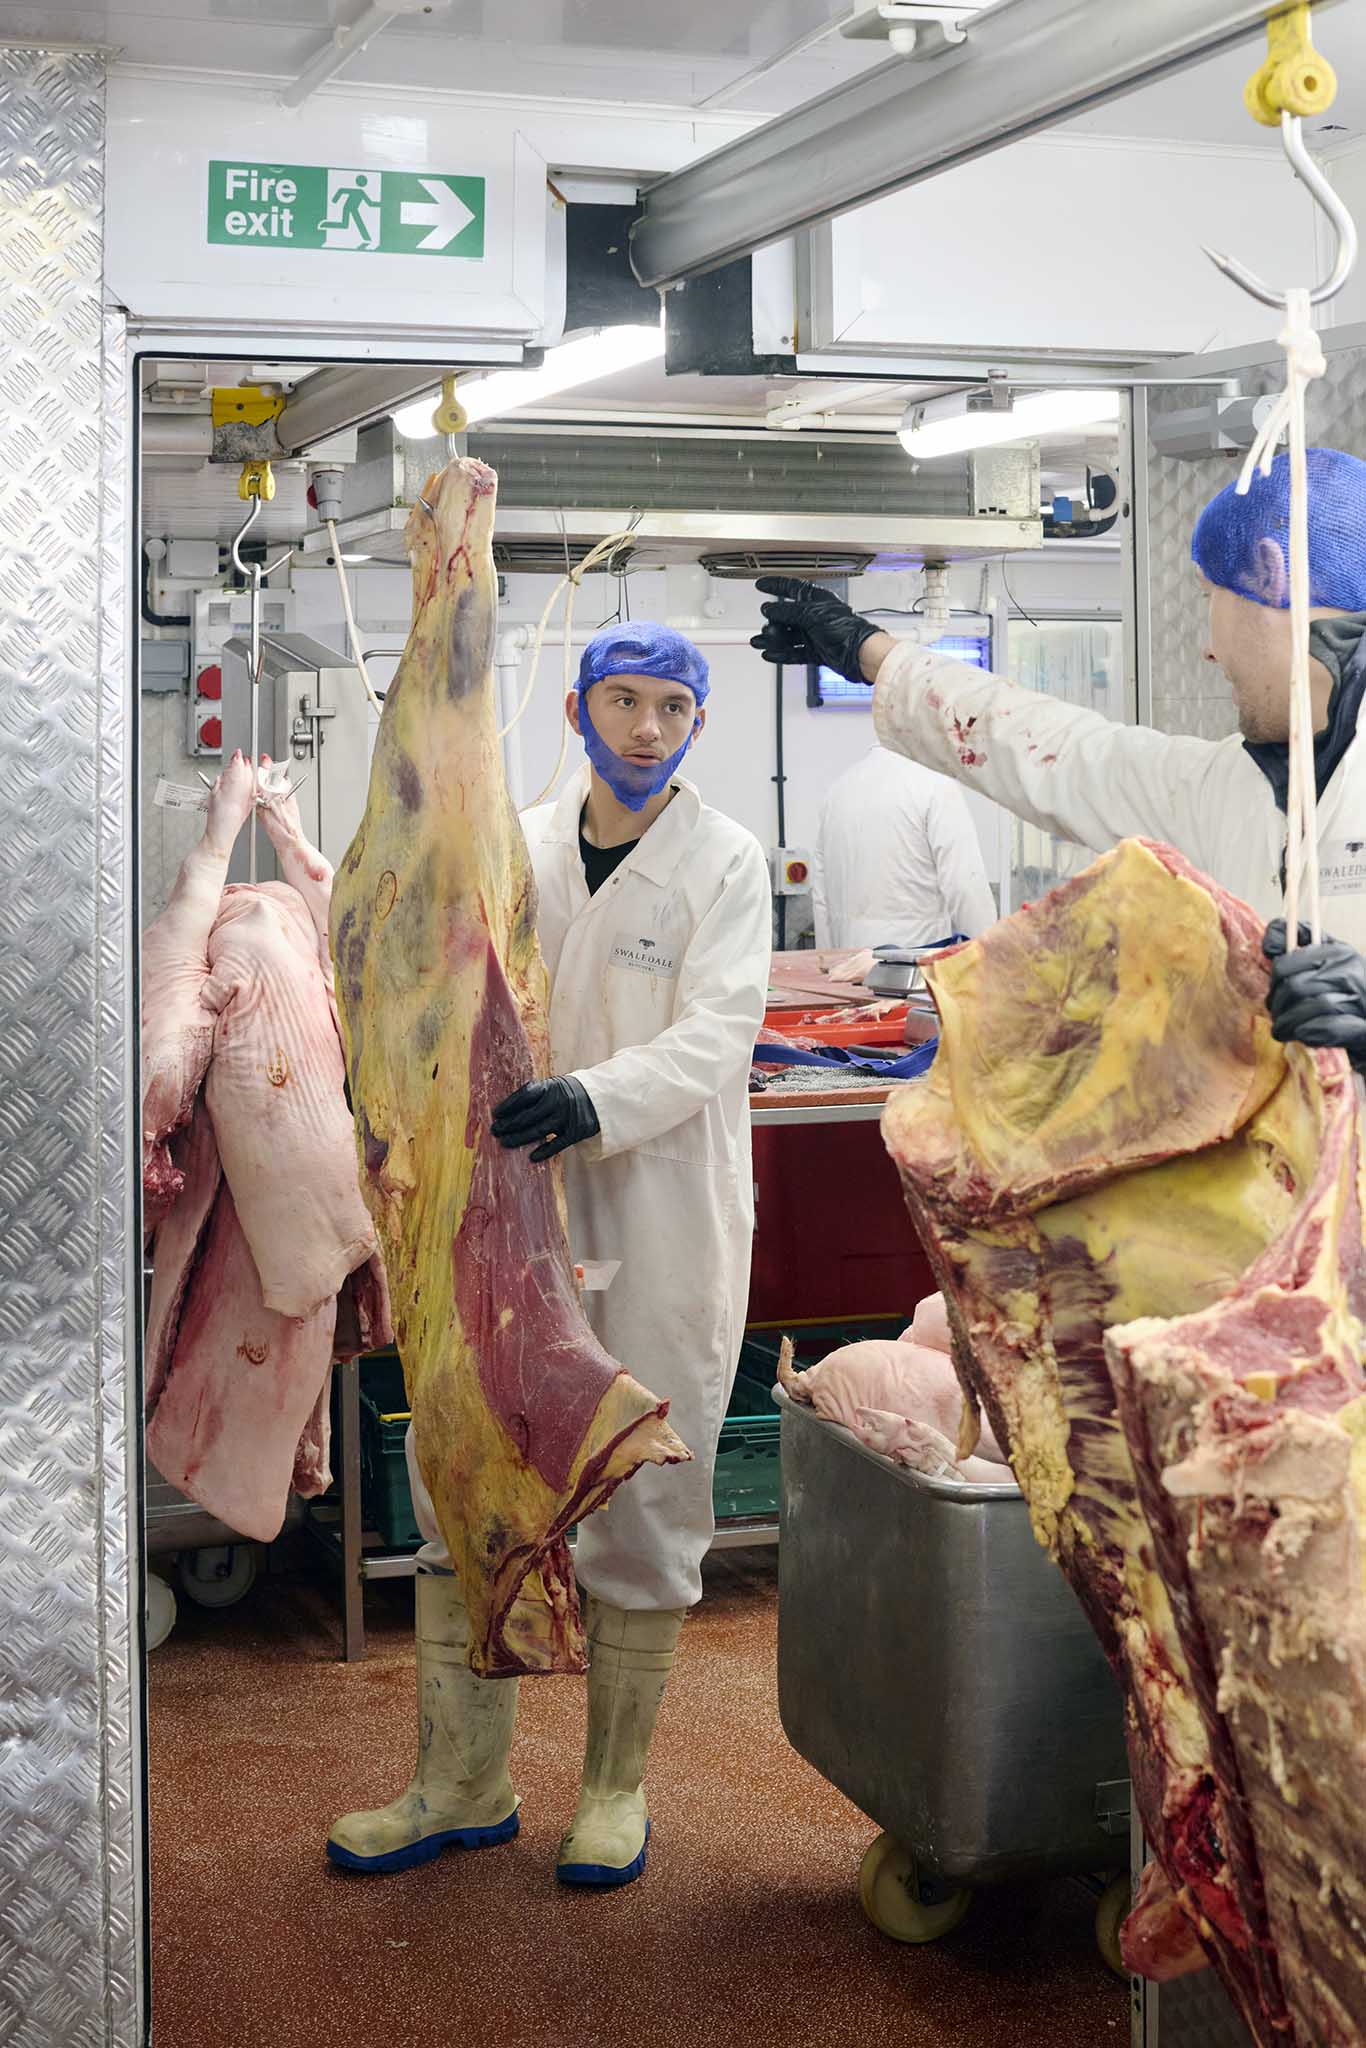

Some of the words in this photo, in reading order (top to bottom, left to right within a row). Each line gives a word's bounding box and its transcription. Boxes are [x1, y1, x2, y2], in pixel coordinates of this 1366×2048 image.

[226, 169, 297, 203] Fire
[225, 206, 294, 238] exit
[615, 947, 673, 969] SWALEDALE
